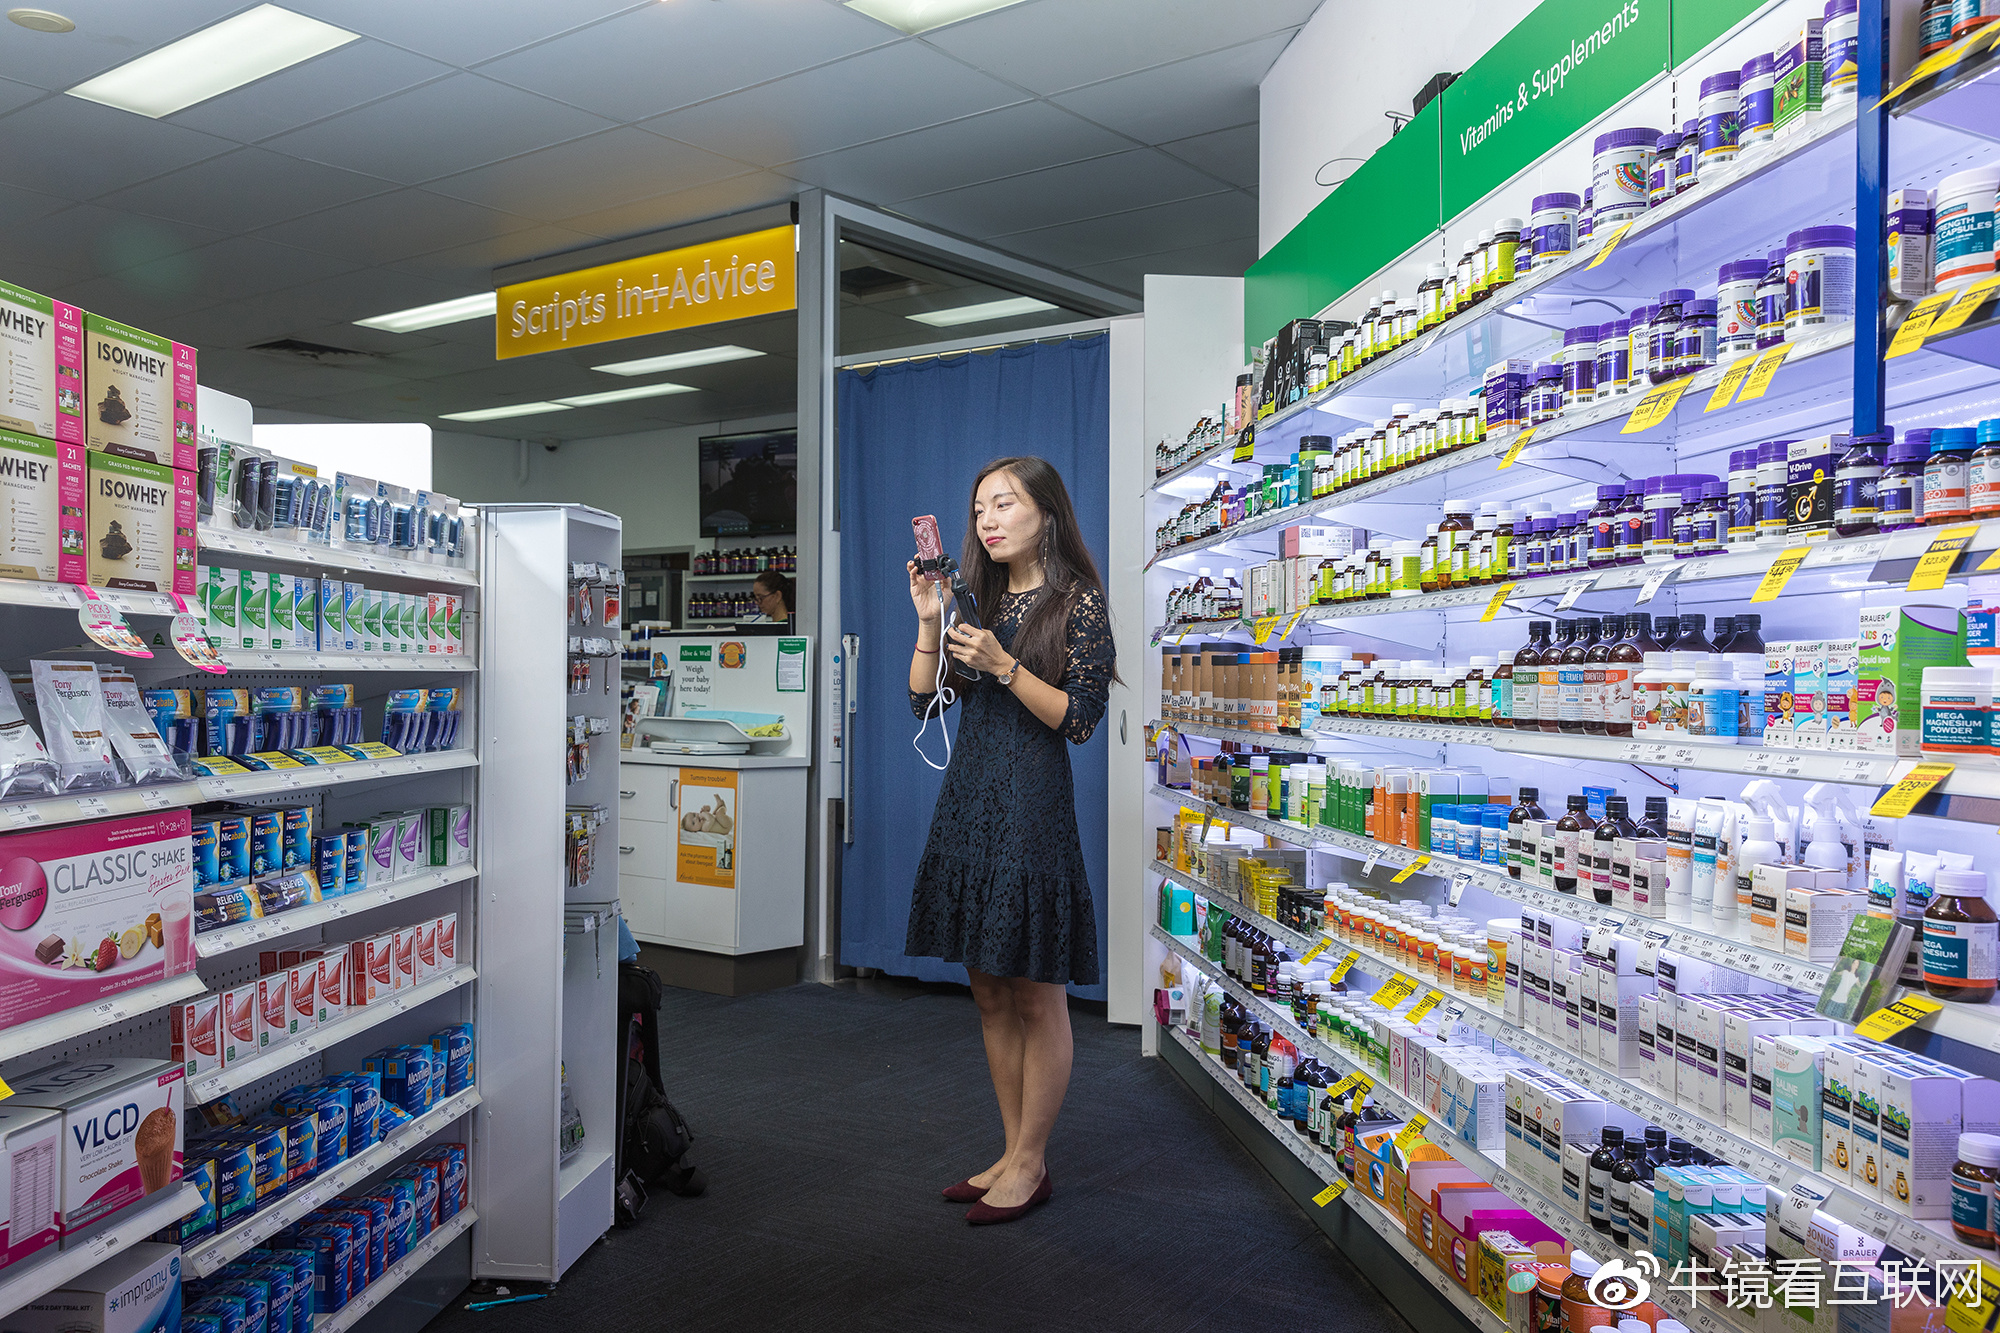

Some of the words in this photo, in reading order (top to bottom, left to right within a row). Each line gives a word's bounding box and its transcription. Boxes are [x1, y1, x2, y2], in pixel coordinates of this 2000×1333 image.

[1460, 103, 1514, 156] Vitamins
[1517, 82, 1529, 112] &
[1532, 0, 1639, 98] Supplements
[1617, 165, 1644, 192] Powder
[1942, 220, 1992, 238] CAPSULES
[16, 292, 36, 304] PROTEIN
[64, 308, 72, 320] 21
[511, 290, 606, 341] Scripts
[59, 321, 78, 332] SACHETS
[1, 332, 32, 345] MANAGEMENT
[62, 335, 75, 345] +FREE
[106, 325, 120, 334] GRASS
[129, 332, 140, 341] WHEY
[141, 336, 158, 346] PROTEIN
[97, 341, 166, 378] ISOWHEY
[181, 349, 189, 360] 21
[177, 360, 192, 370] SACHETS
[112, 368, 128, 377] WEIGHT
[129, 372, 156, 384] MANAGEMENT
[18, 439, 39, 448] PROTEIN
[67, 448, 76, 460] 21
[62, 462, 81, 471] SACHETS
[108, 461, 122, 469] GRASS
[131, 466, 143, 474] WHEY
[1789, 462, 1812, 473] V-Drive
[66, 475, 79, 483] +FREE
[182, 476, 190, 486] 21
[3, 481, 36, 491] MANAGEMENT
[100, 477, 167, 506] ISOWHEY
[178, 488, 193, 496] SACHETS
[130, 506, 156, 514] MANAGEMENT
[1924, 556, 1949, 565] $23.99
[87, 603, 103, 614] PICK
[104, 605, 110, 614] 3
[178, 616, 190, 626] PICK
[190, 617, 195, 626] 3
[1860, 615, 1885, 623] BRAUER
[1861, 630, 1877, 640] KIDS
[1796, 644, 1818, 652] BRAUER
[1828, 644, 1852, 652] BRAUER
[1766, 660, 1779, 668] KIDS
[1859, 655, 1876, 665] Liquid
[1878, 656, 1891, 664] Iron
[686, 665, 704, 673] Weigh
[53, 679, 72, 691] Tony
[57, 690, 91, 699] Ferguson
[104, 690, 122, 700] Tony
[144, 697, 174, 708] Nicabate
[207, 697, 233, 708] Nicabate
[1936, 712, 1965, 720] MEGA
[1926, 719, 1982, 727] MAGNESIUM
[1931, 726, 1973, 734] POWDER
[255, 826, 279, 836] Nicabate
[286, 821, 308, 830] Nicabate
[221, 831, 247, 842] Nicabate
[323, 849, 343, 858] Nicabate
[54, 850, 147, 894] CLASSIC
[151, 847, 186, 869] SHAKE
[0, 881, 22, 896] Tony
[280, 878, 304, 891] RELIEVES
[1873, 878, 1896, 898] Kids
[1908, 878, 1933, 898] Kids
[216, 892, 243, 906] RELIEVES
[282, 892, 290, 905] 5
[220, 907, 227, 921] 5
[1890, 1002, 1926, 1020] WOW!
[192, 1030, 215, 1045] nicorette
[1776, 1044, 1795, 1056] BRAUER
[1457, 1074, 1464, 1093] Ki
[1478, 1085, 1488, 1093] Ki
[1776, 1077, 1798, 1096] SALINE
[1830, 1079, 1852, 1102] Kids
[1859, 1091, 1879, 1115] Kids
[1887, 1105, 1910, 1130] Kids
[72, 1102, 139, 1153] VLCD
[289, 1131, 313, 1148] Nicabate
[80, 1151, 91, 1162] VERY
[104, 1140, 122, 1153] CALORIE
[123, 1135, 132, 1146] DIET
[256, 1146, 281, 1163] Nicabate
[79, 1167, 107, 1183] Chocolate
[108, 1159, 123, 1171] Shake
[222, 1164, 250, 1182] Nicabate
[120, 1268, 168, 1309] impromy
